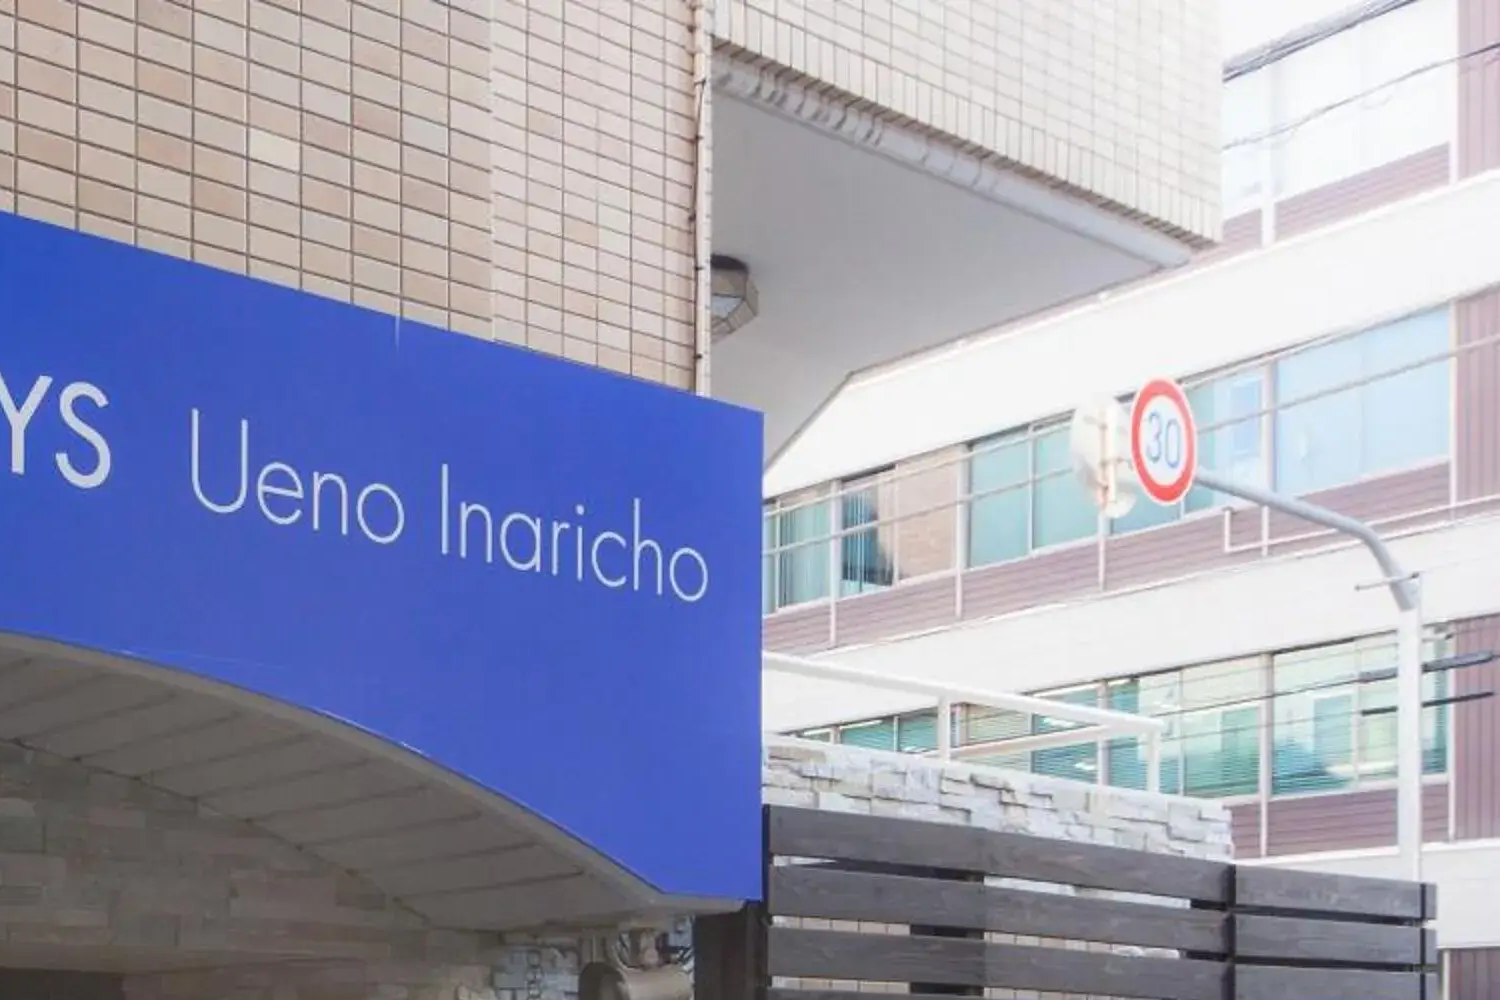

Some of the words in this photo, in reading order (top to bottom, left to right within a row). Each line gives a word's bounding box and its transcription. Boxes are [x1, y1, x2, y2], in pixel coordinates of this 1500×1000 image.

[1146, 410, 1181, 468] 30
[190, 407, 407, 546] Ueno
[440, 462, 709, 603] Inaricho
